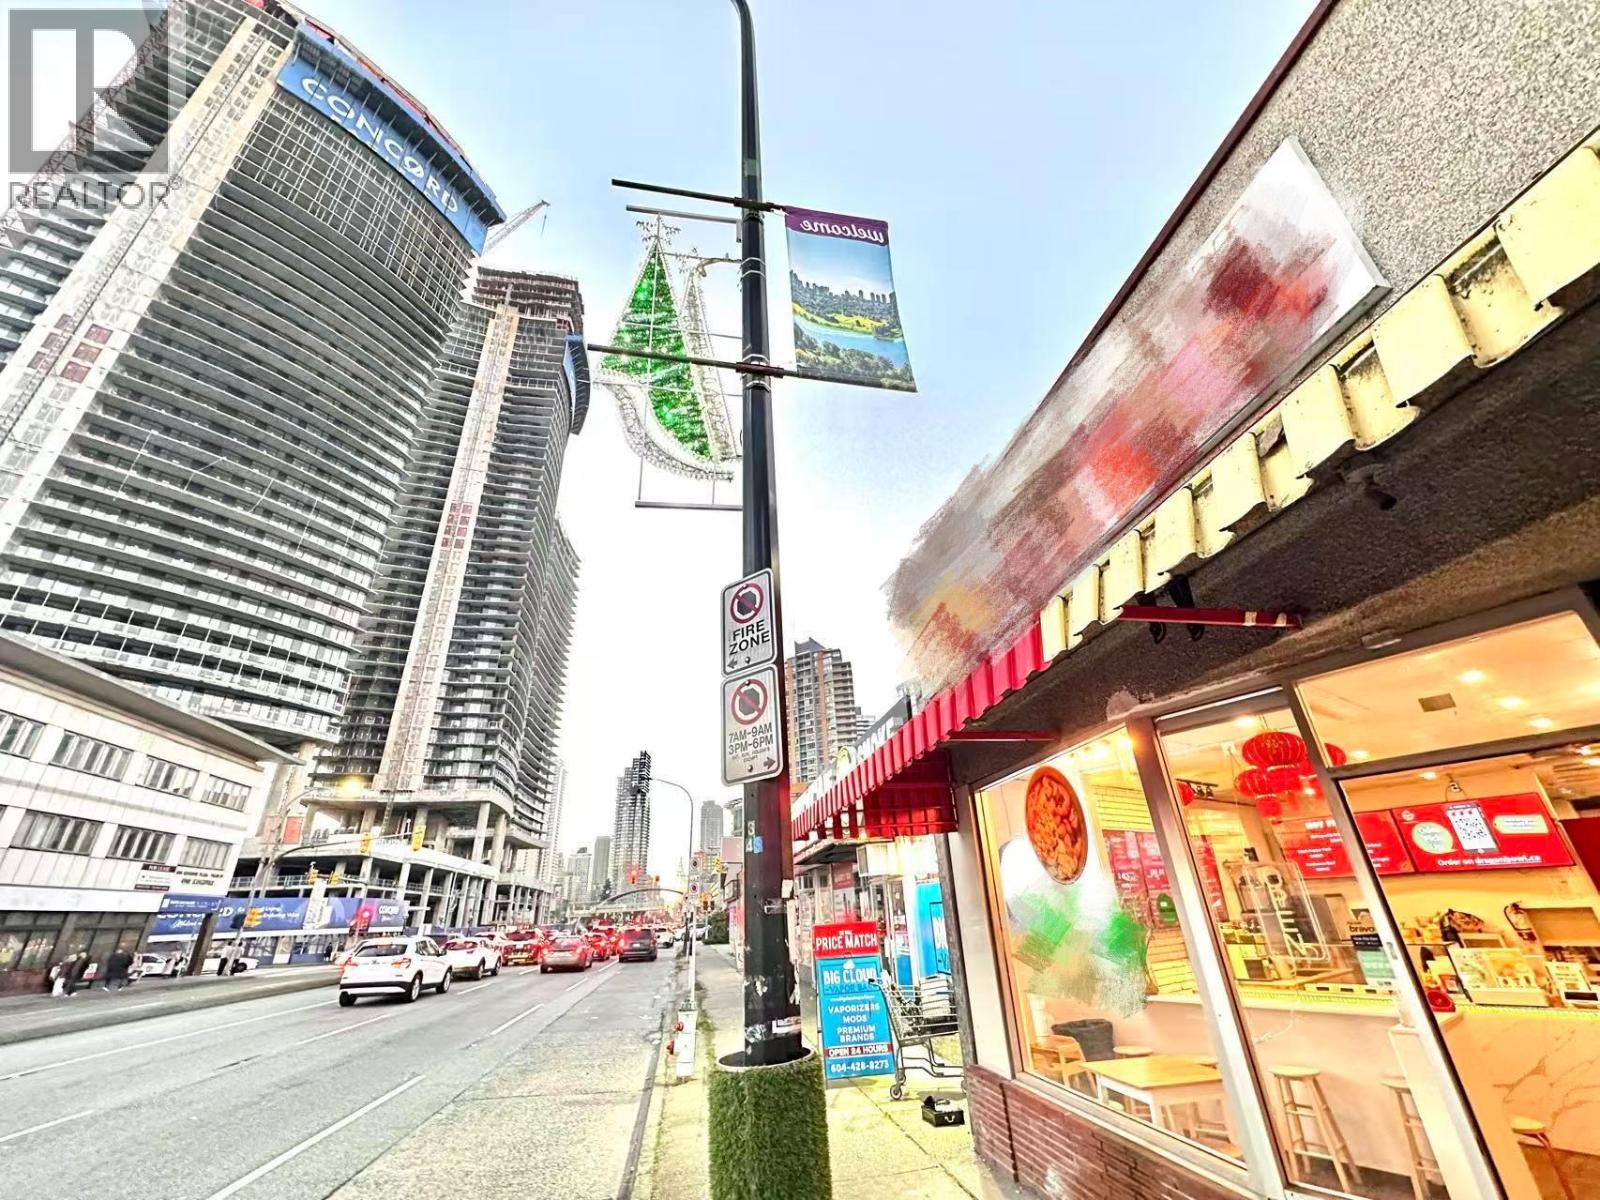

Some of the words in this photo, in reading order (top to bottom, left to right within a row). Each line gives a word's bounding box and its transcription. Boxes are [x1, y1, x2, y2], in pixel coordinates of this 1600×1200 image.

[302, 78, 458, 212] CONCORD
[732, 619, 765, 641] FIRE
[729, 630, 770, 655] ZONE
[729, 722, 773, 743] 7AM-9AM
[728, 734, 774, 755] 3PM-6PM
[1265, 873, 1308, 956] OPEN
[815, 936, 844, 951] PRICE
[844, 933, 878, 949] MATCH
[823, 970, 841, 985] BIG
[842, 967, 878, 984] CLOUD
[828, 1003, 880, 1014] VAPORIZERS
[842, 1015, 867, 1023] MODS
[837, 1025, 876, 1035] PREMIUM
[840, 1033, 875, 1043] BRANDS
[828, 1047, 849, 1057] OPEN
[850, 1047, 862, 1055] 24
[863, 1044, 889, 1054] HOURS
